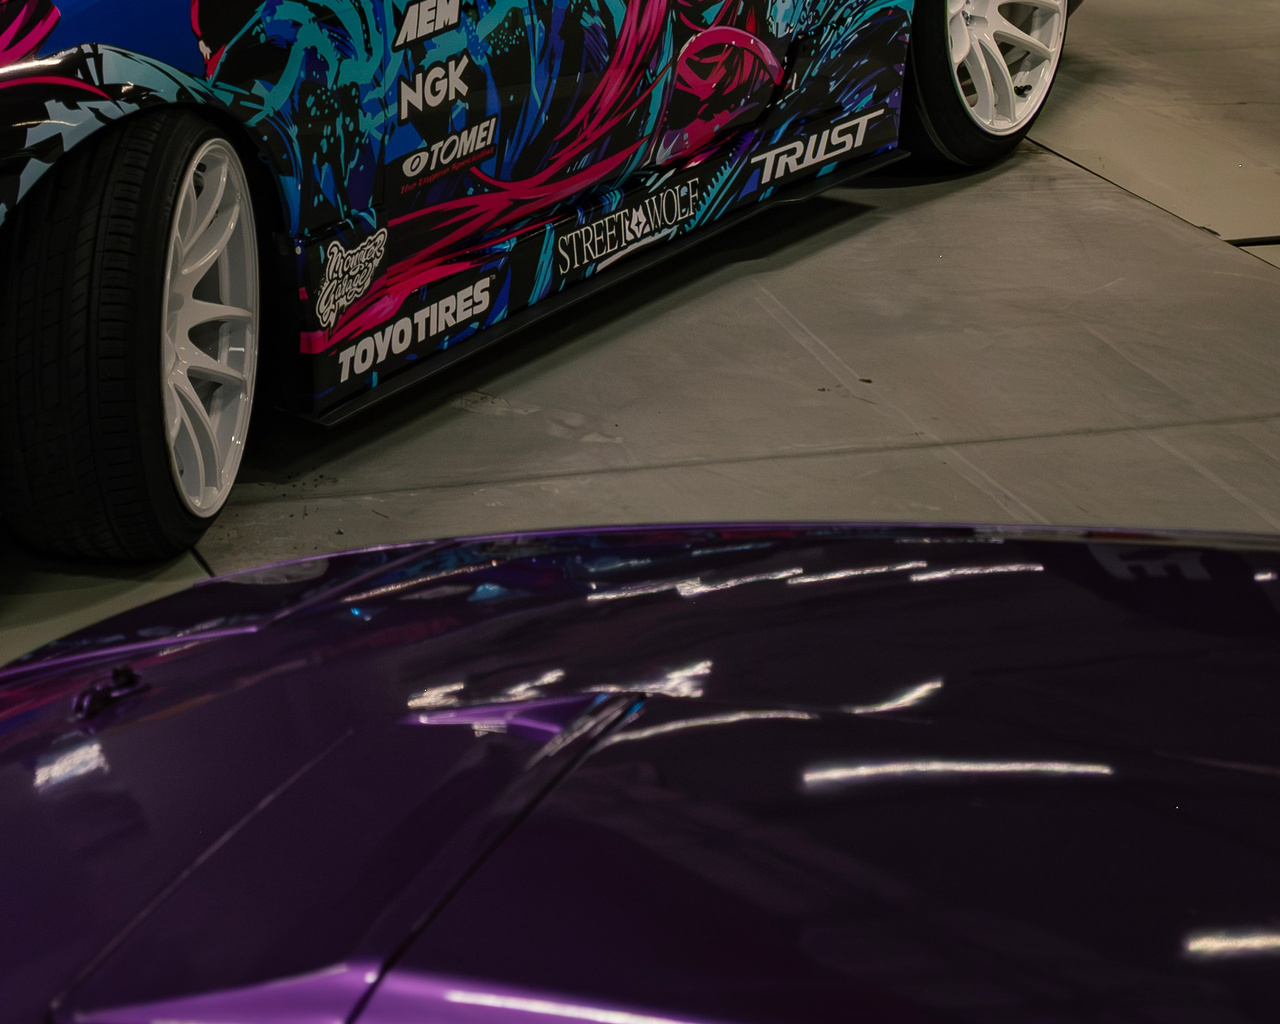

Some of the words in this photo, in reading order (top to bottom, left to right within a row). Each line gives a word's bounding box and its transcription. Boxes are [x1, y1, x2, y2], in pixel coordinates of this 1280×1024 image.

[400, 55, 469, 120] NGK
[430, 118, 497, 171] TOMEI
[750, 108, 886, 185] TRUST
[557, 208, 630, 276] STREET
[644, 177, 700, 232] WOLF
[338, 316, 413, 384] TOYO
[414, 276, 491, 343] TIRES
